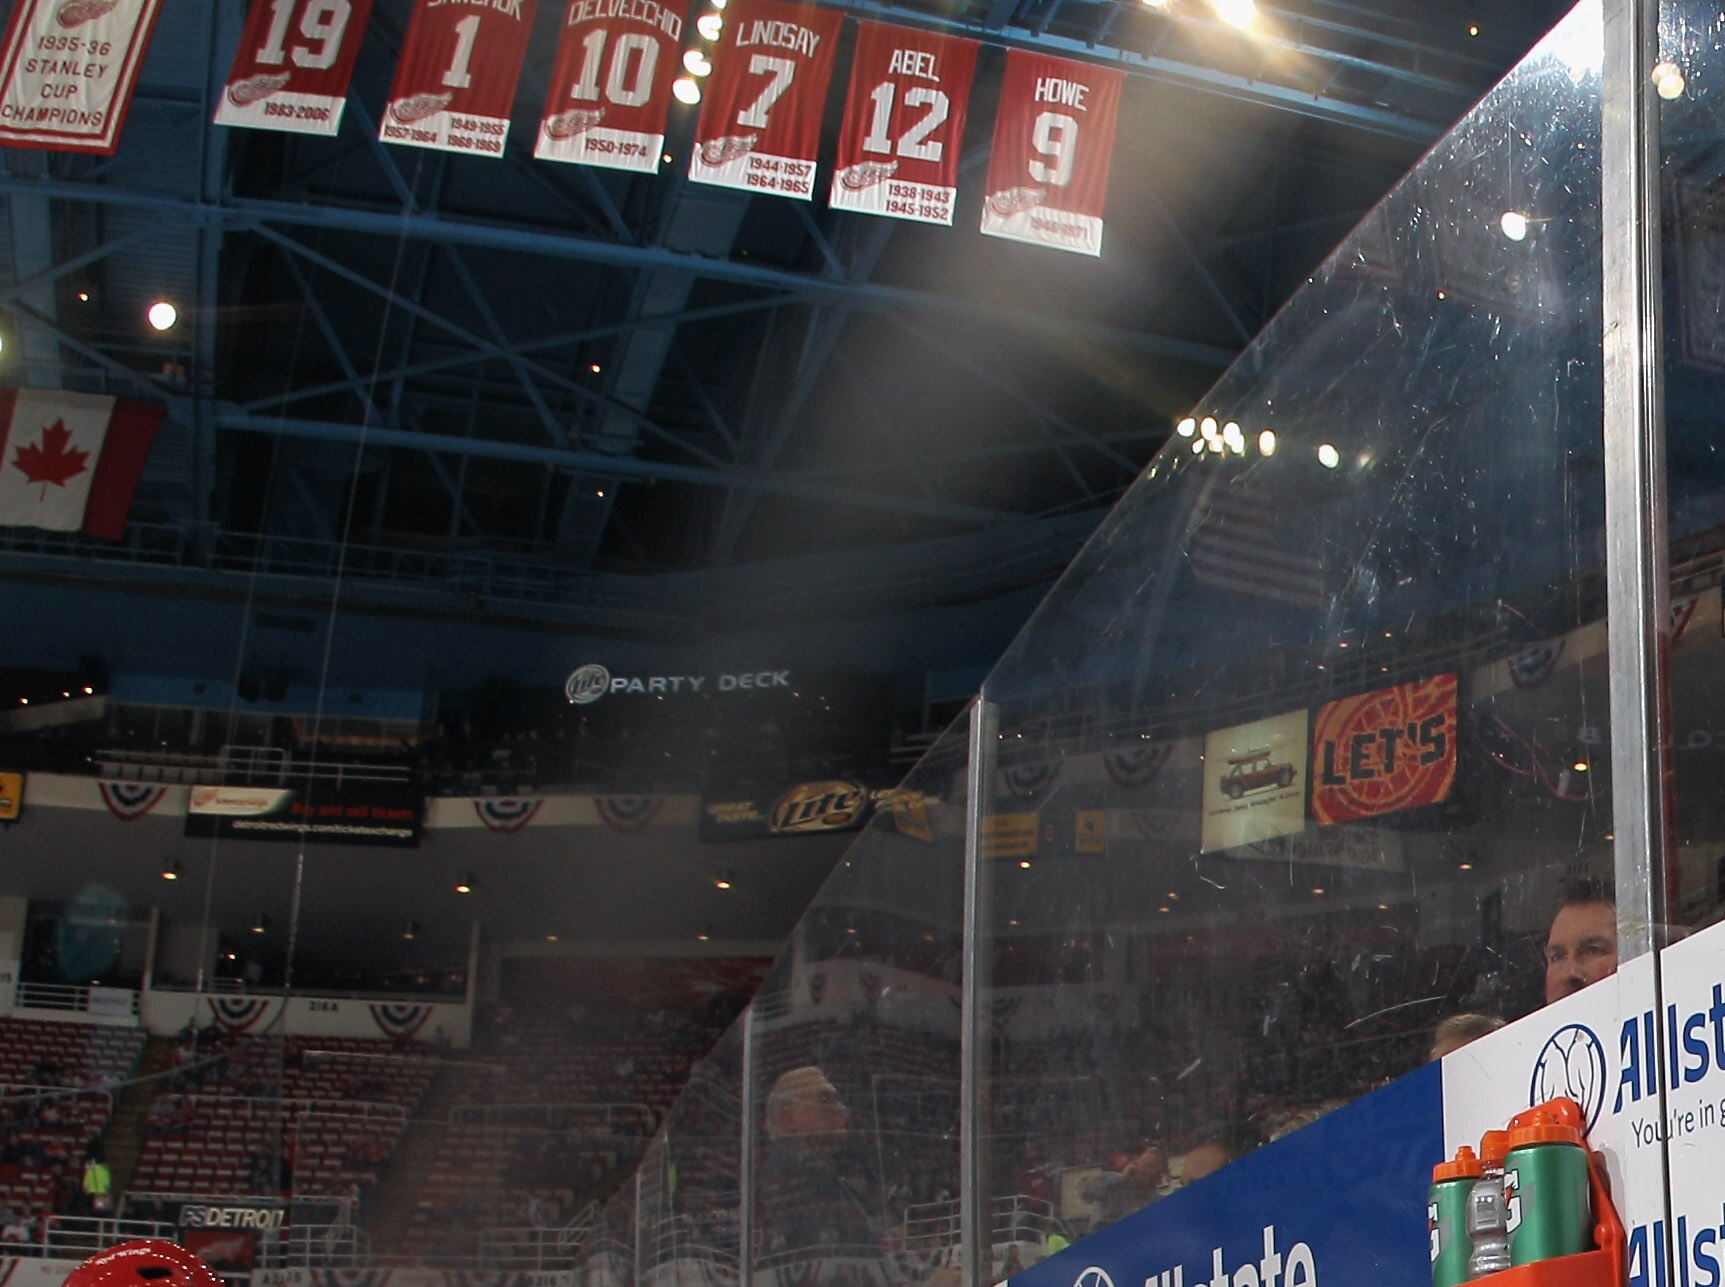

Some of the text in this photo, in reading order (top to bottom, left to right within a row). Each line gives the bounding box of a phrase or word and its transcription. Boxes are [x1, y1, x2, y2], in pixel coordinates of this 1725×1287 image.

[256, 0, 351, 69] 19
[568, 0, 682, 42] DELVECCHIO
[441, 15, 481, 89] 1
[736, 20, 820, 58] LINDSAY
[25, 58, 108, 79] STANLEY
[570, 29, 659, 108] 10
[888, 49, 940, 82] ABEL
[41, 83, 77, 100] CUP
[736, 53, 796, 129] 7
[1034, 77, 1090, 112] HOWE
[1, 103, 103, 126] CHAMPIONS
[862, 81, 950, 163] 12
[585, 136, 648, 157] 1950-1974
[1027, 110, 1079, 188] 9
[746, 173, 809, 195] 1964-1965
[750, 157, 812, 178] 1944-1957
[885, 199, 948, 221] 1945-1952
[888, 183, 949, 204] 1938-1943
[610, 676, 704, 694] PARTY
[719, 670, 790, 692] DECK
[1321, 712, 1447, 786] LET'S
[1699, 1098, 1715, 1129] in
